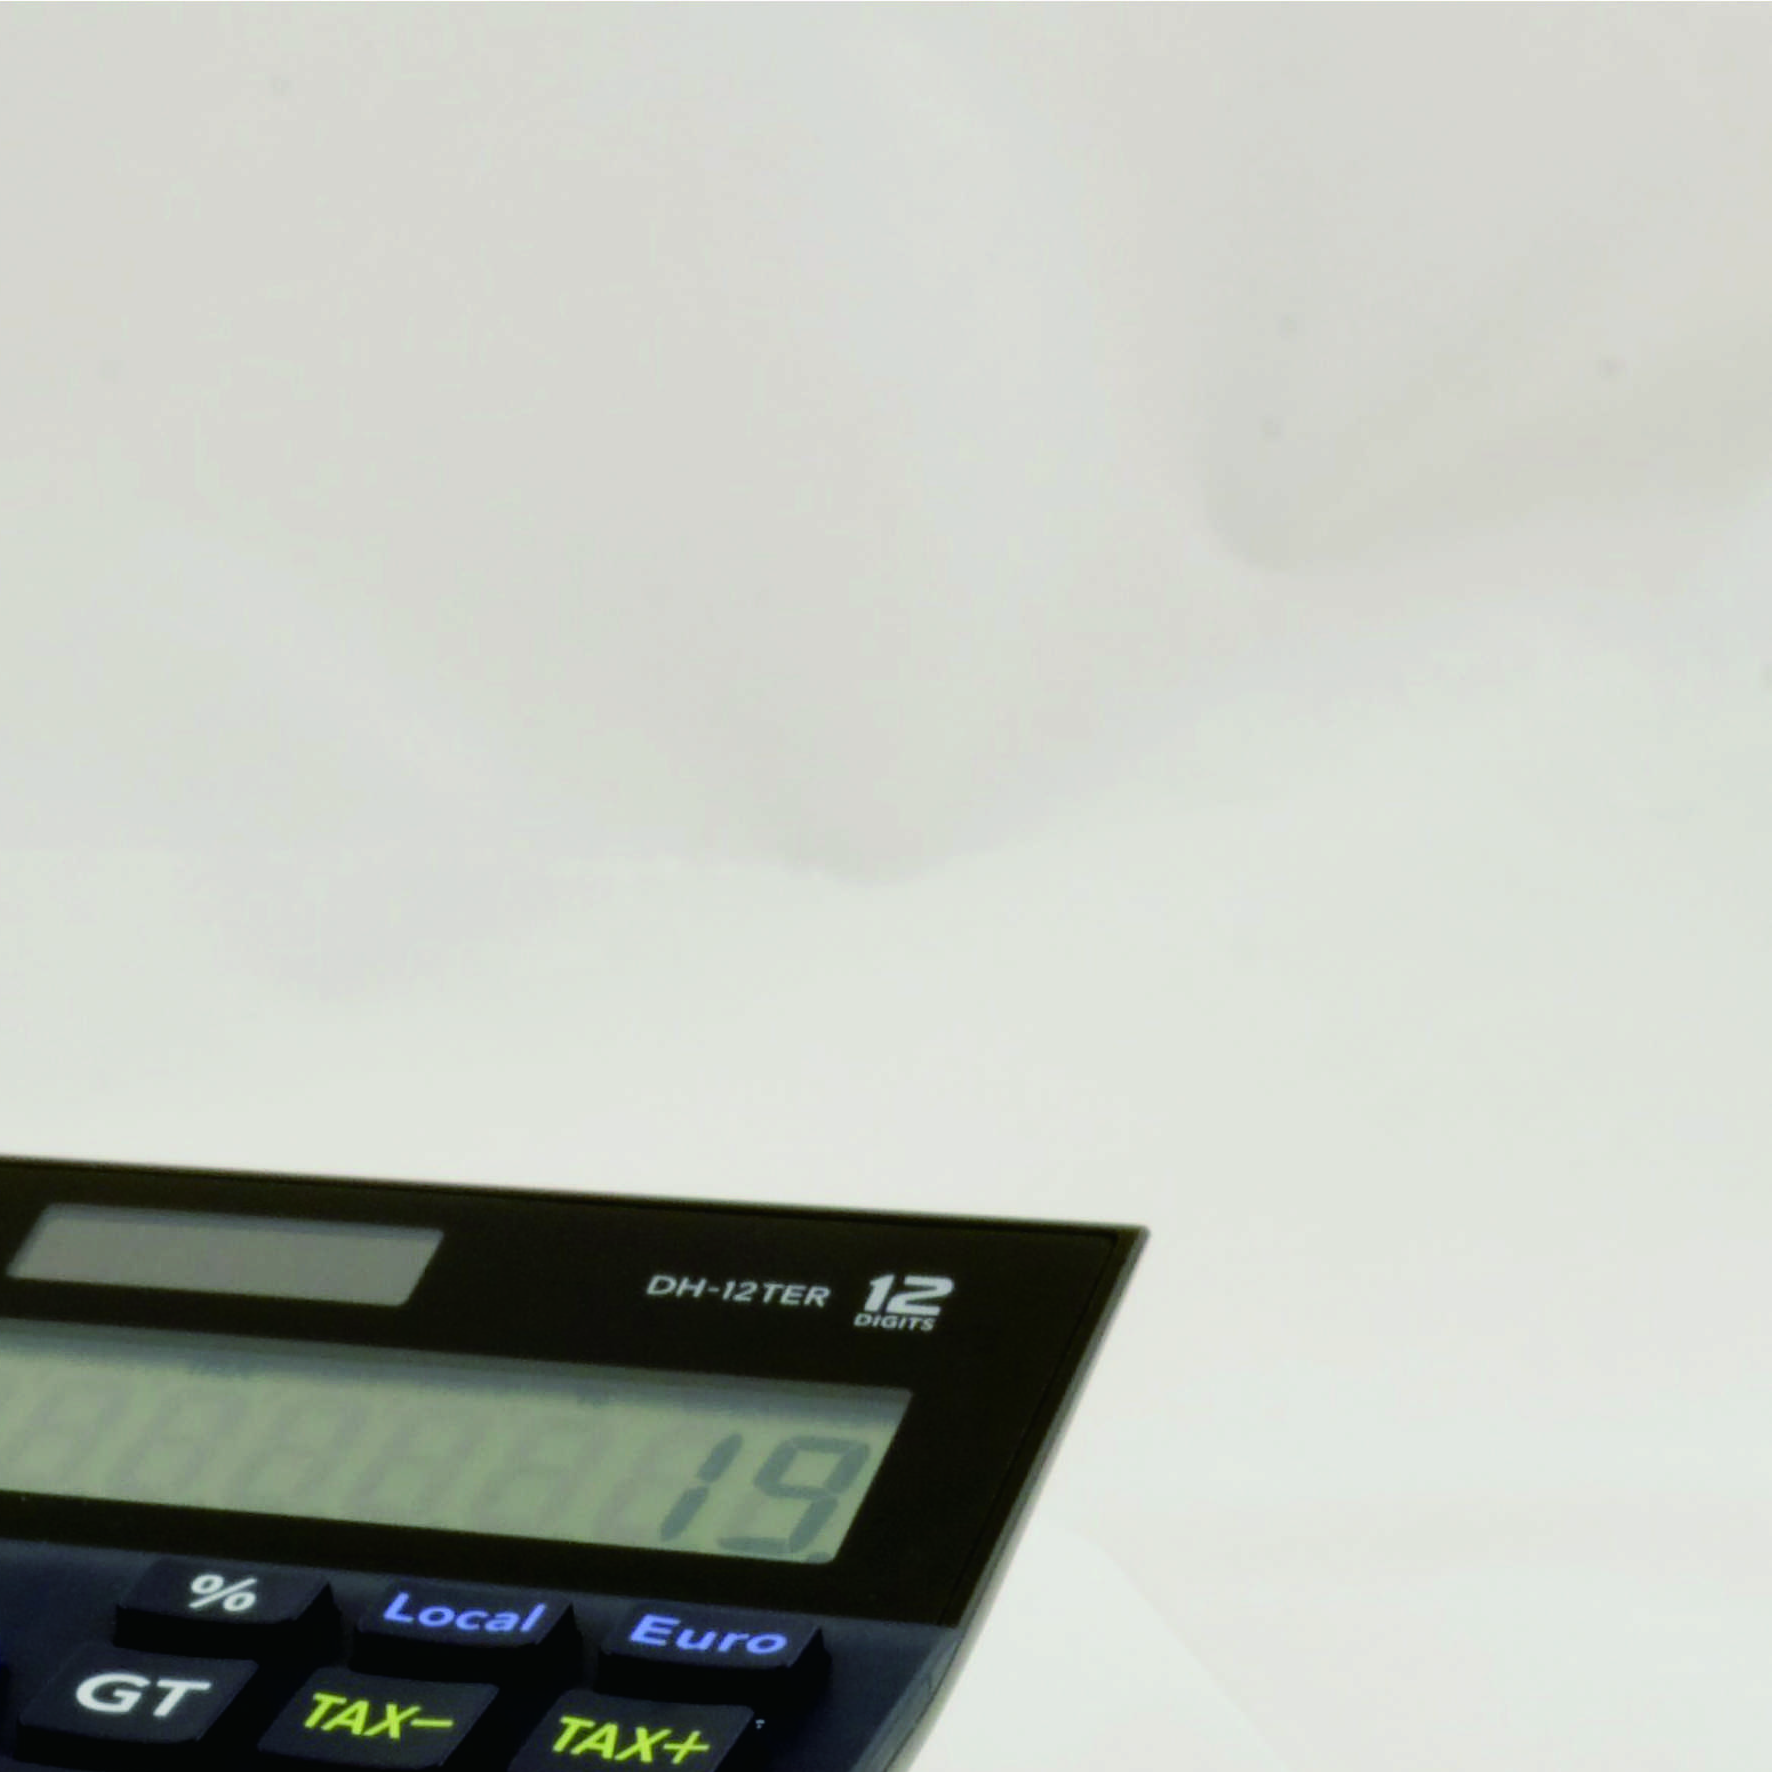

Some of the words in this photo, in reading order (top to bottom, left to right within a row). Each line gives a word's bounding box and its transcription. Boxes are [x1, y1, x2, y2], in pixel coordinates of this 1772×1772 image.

[647, 1275, 830, 1307] DH-12TER
[856, 1275, 953, 1316] 12
[855, 1311, 940, 1330] DIGITS
[384, 1592, 546, 1632] Local
[630, 1614, 787, 1654] Euro
[76, 1672, 211, 1717] GT
[553, 1717, 709, 1764] TAX+
